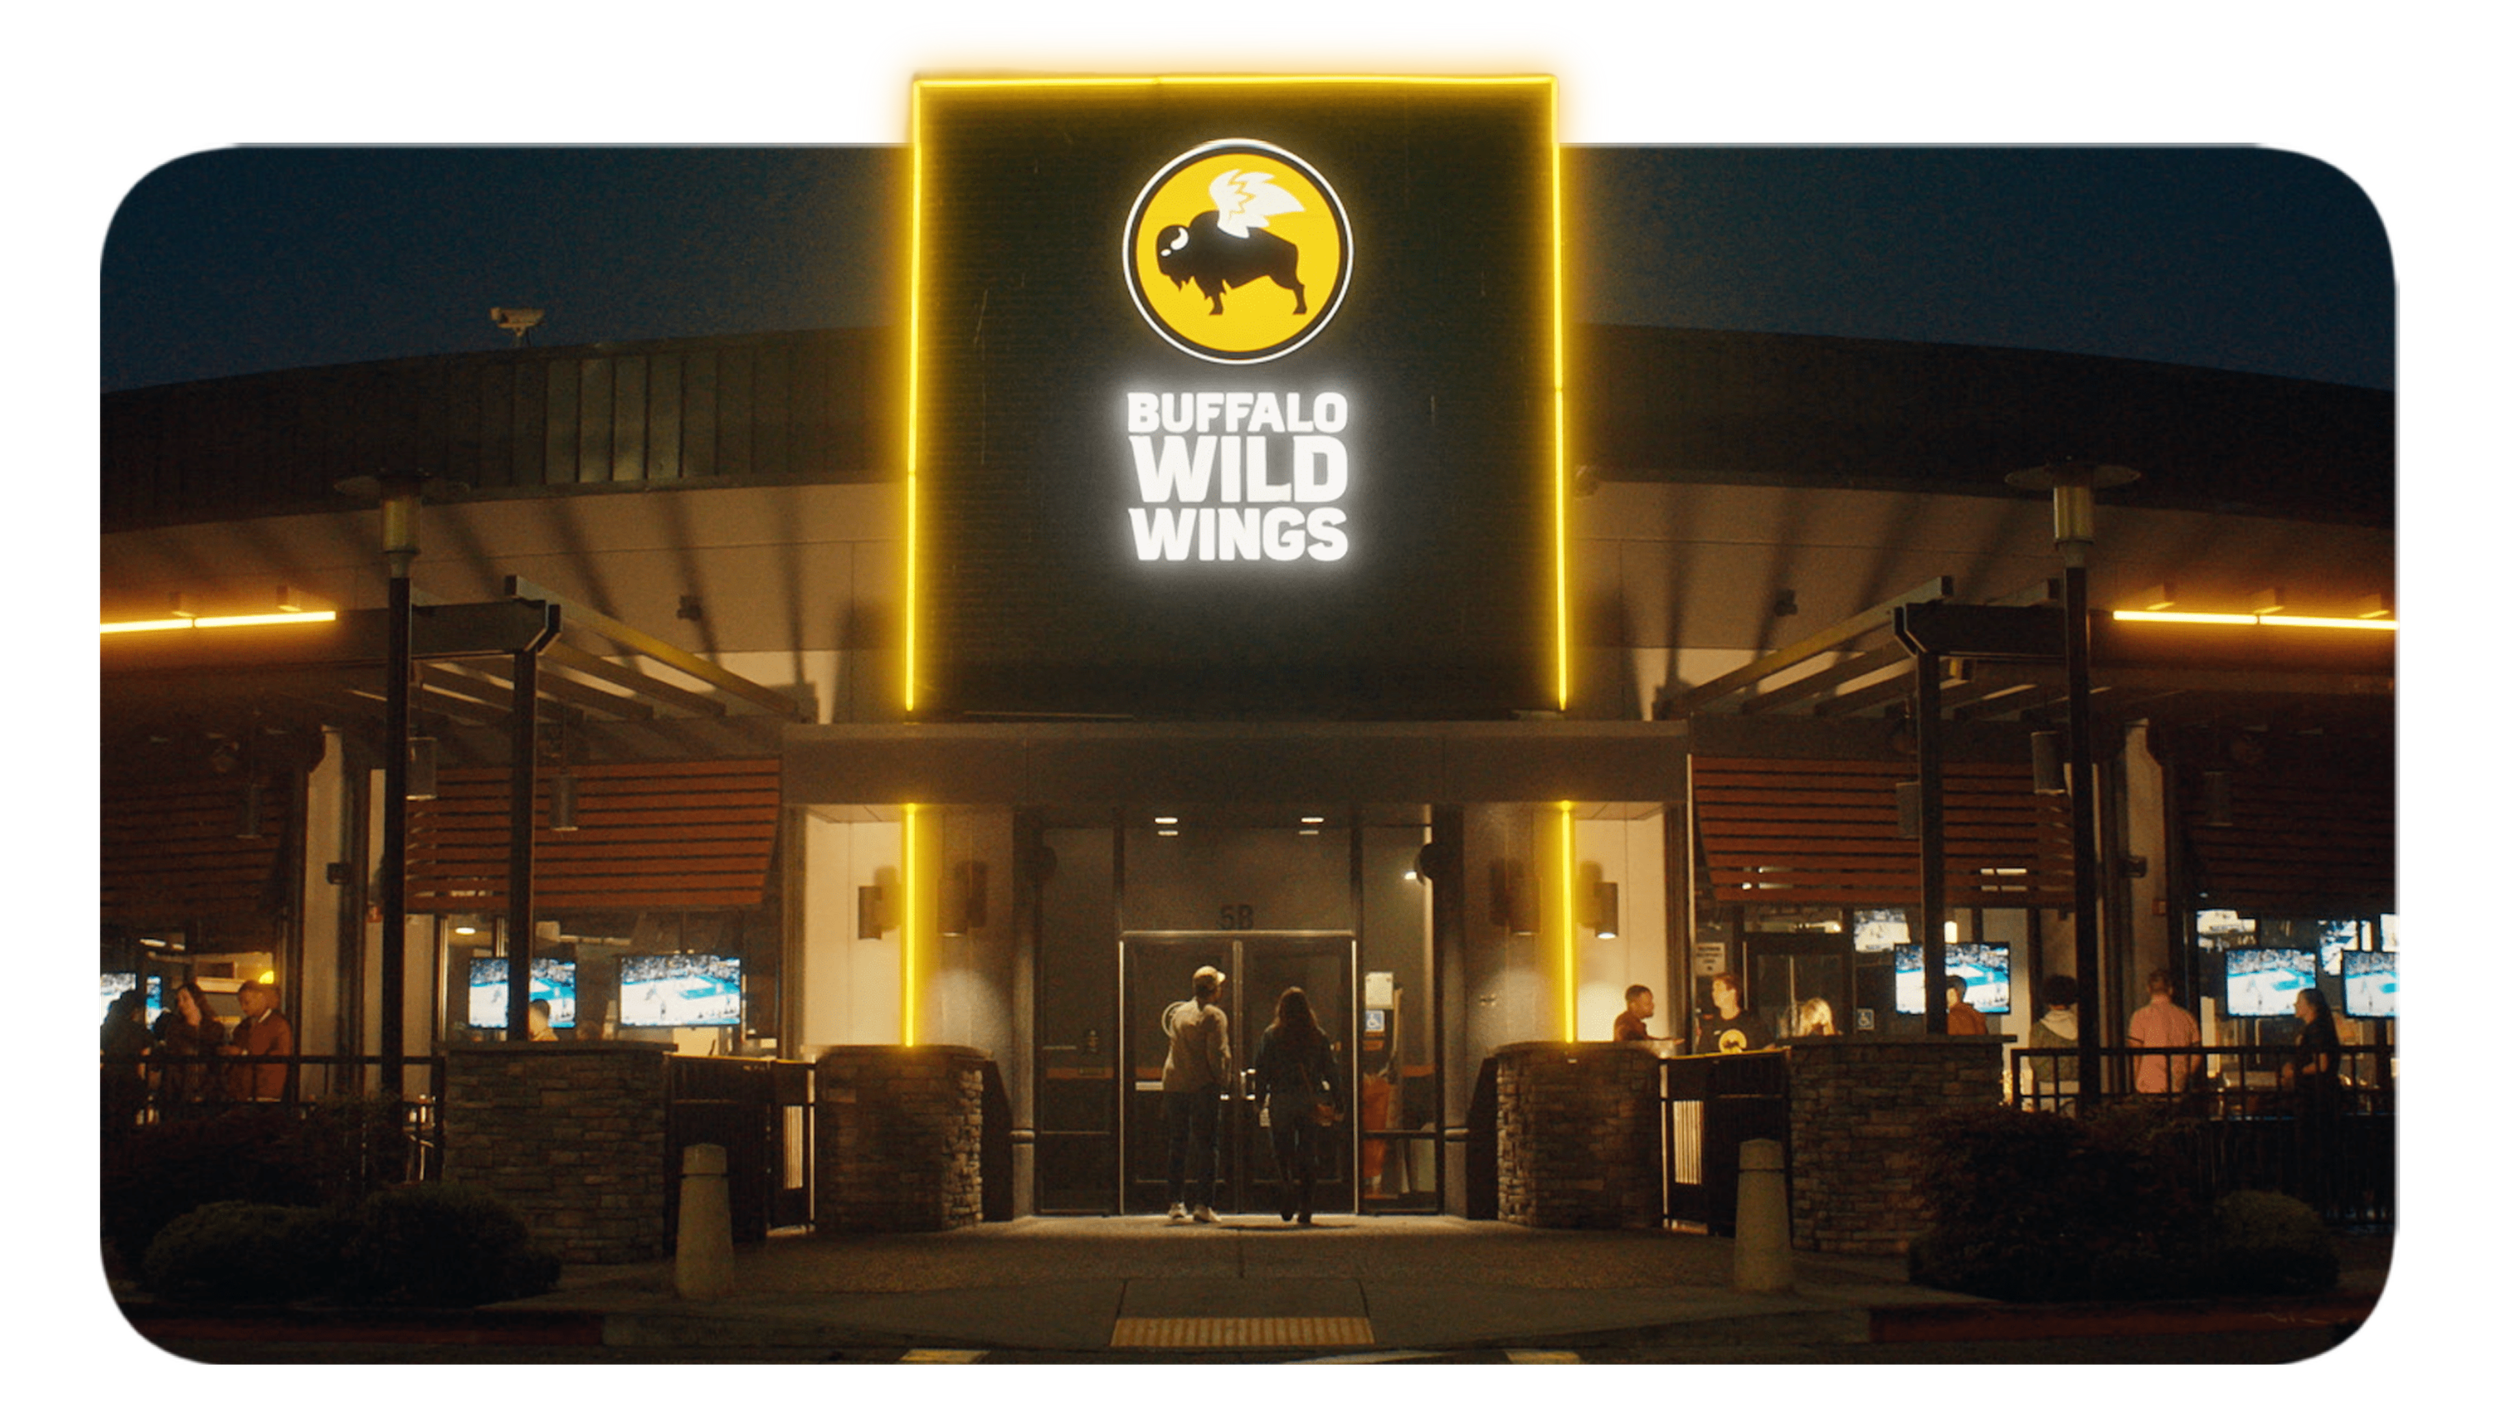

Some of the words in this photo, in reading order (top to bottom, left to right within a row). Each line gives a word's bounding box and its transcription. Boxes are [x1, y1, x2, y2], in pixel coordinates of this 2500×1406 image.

[1127, 391, 1348, 433] BUFFALO
[1128, 435, 1348, 502] WILD
[1128, 507, 1349, 561] WINGS
